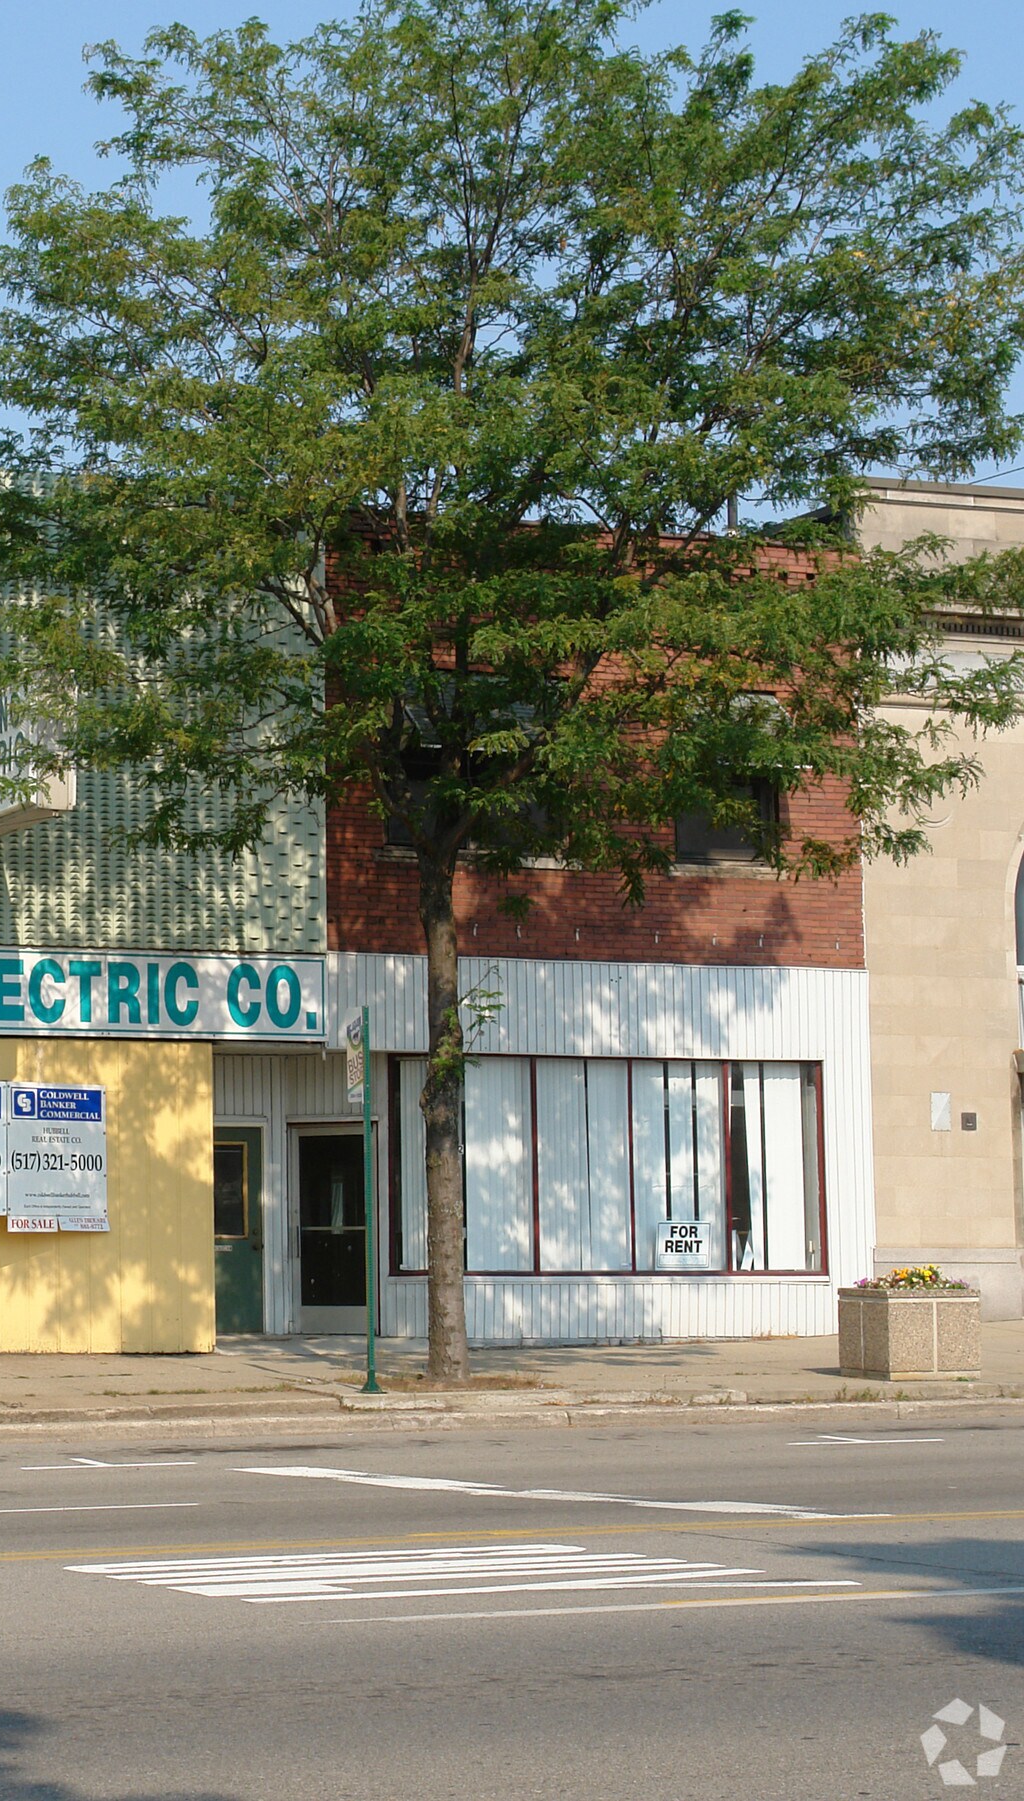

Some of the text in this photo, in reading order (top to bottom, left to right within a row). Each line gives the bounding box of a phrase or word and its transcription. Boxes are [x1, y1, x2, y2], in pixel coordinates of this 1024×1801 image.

[227, 963, 318, 1031] CO.
[39, 1090, 89, 1100] COLDWELL
[40, 1100, 76, 1109] BANKER
[40, 1110, 100, 1120] COMMERCIAL
[11, 1150, 103, 1173] (517) 321-5000
[11, 1218, 55, 1229] FOR SALE
[670, 1226, 698, 1238] FOR
[664, 1240, 703, 1253] RENT
